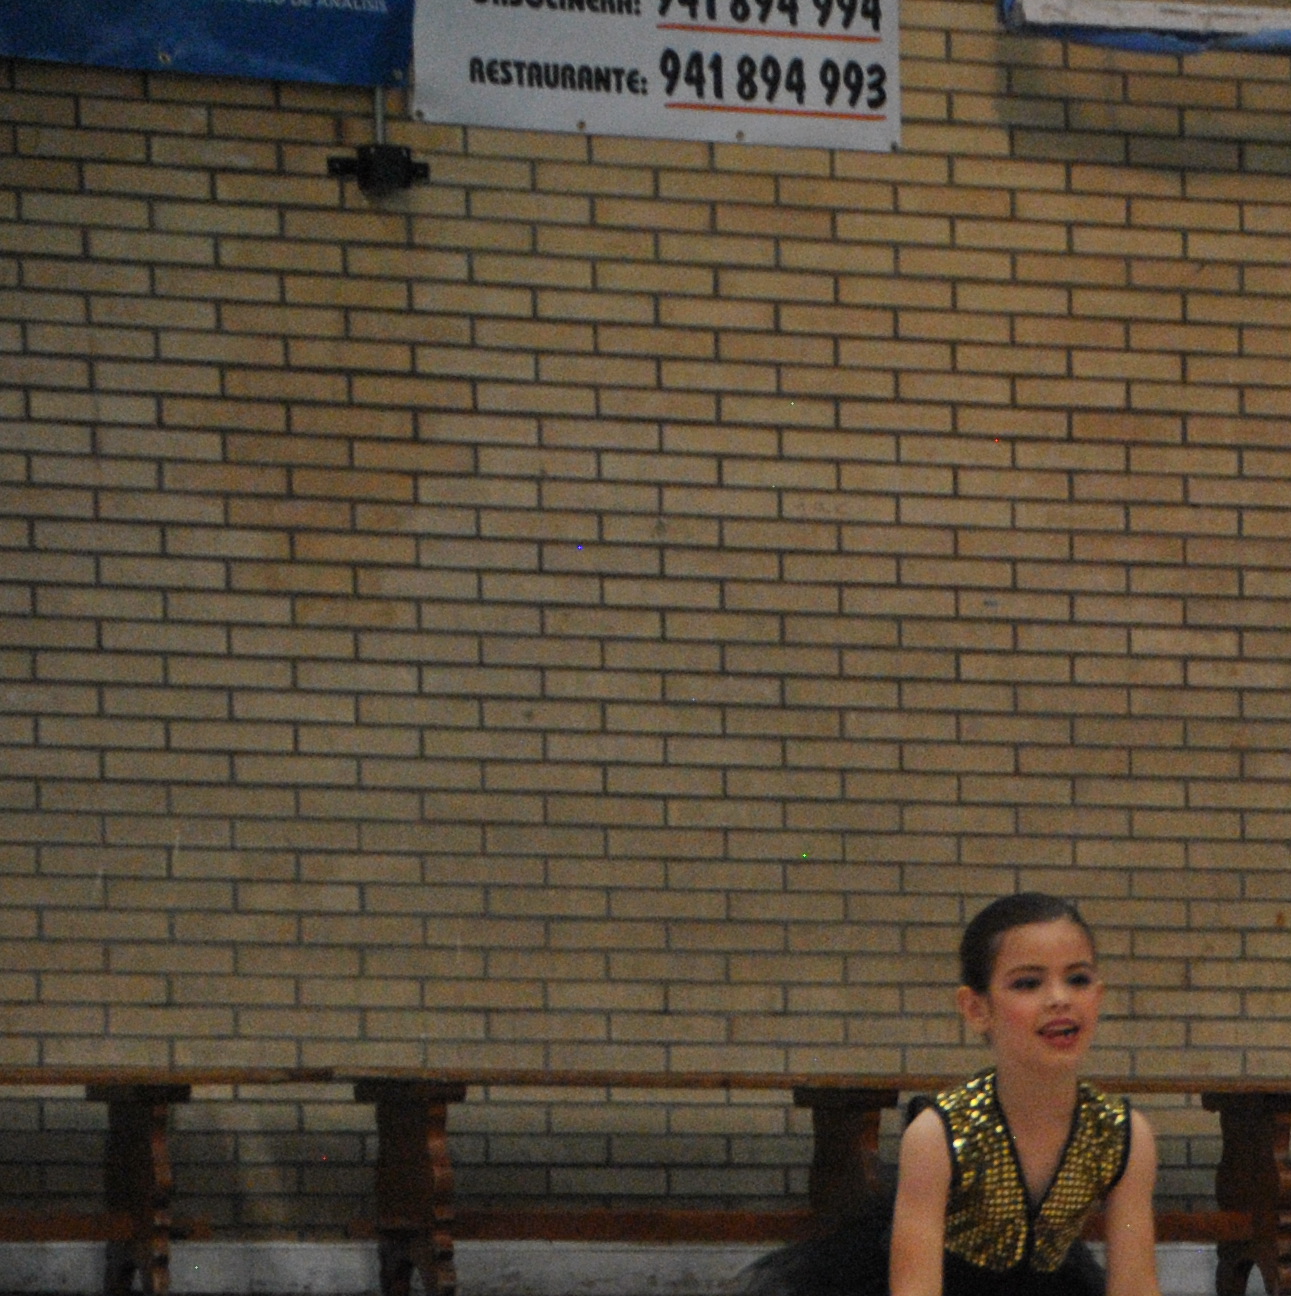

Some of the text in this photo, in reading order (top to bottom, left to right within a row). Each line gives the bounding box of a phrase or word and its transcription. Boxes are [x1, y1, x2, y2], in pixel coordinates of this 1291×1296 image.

[469, 47, 887, 109] RESTAURANTE: 941 894 993
